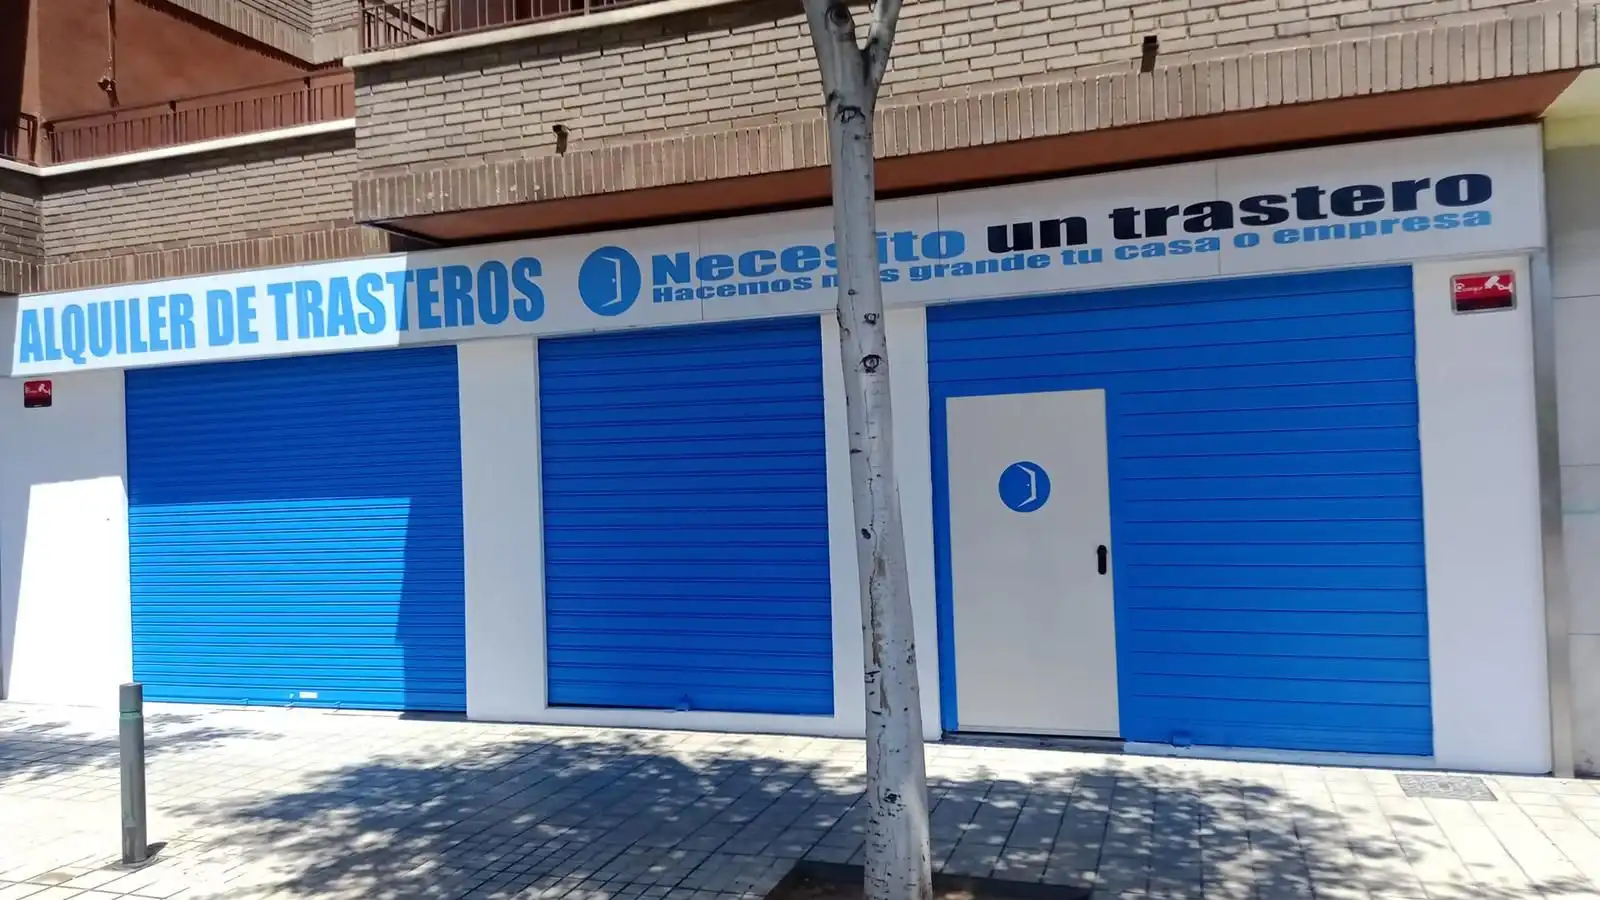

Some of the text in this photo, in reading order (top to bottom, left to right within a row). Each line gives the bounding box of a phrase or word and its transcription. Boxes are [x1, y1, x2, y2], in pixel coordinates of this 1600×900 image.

[652, 276, 813, 304] Hacemos
[909, 252, 1051, 283] grande
[1060, 247, 1104, 267] tu
[1113, 236, 1221, 262] casa
[1233, 232, 1261, 249] o
[1272, 209, 1492, 246] empresa
[988, 216, 1088, 254] un
[1108, 173, 1493, 240] trastero
[19, 256, 546, 365] ALQUILER DE TRASTEROS
